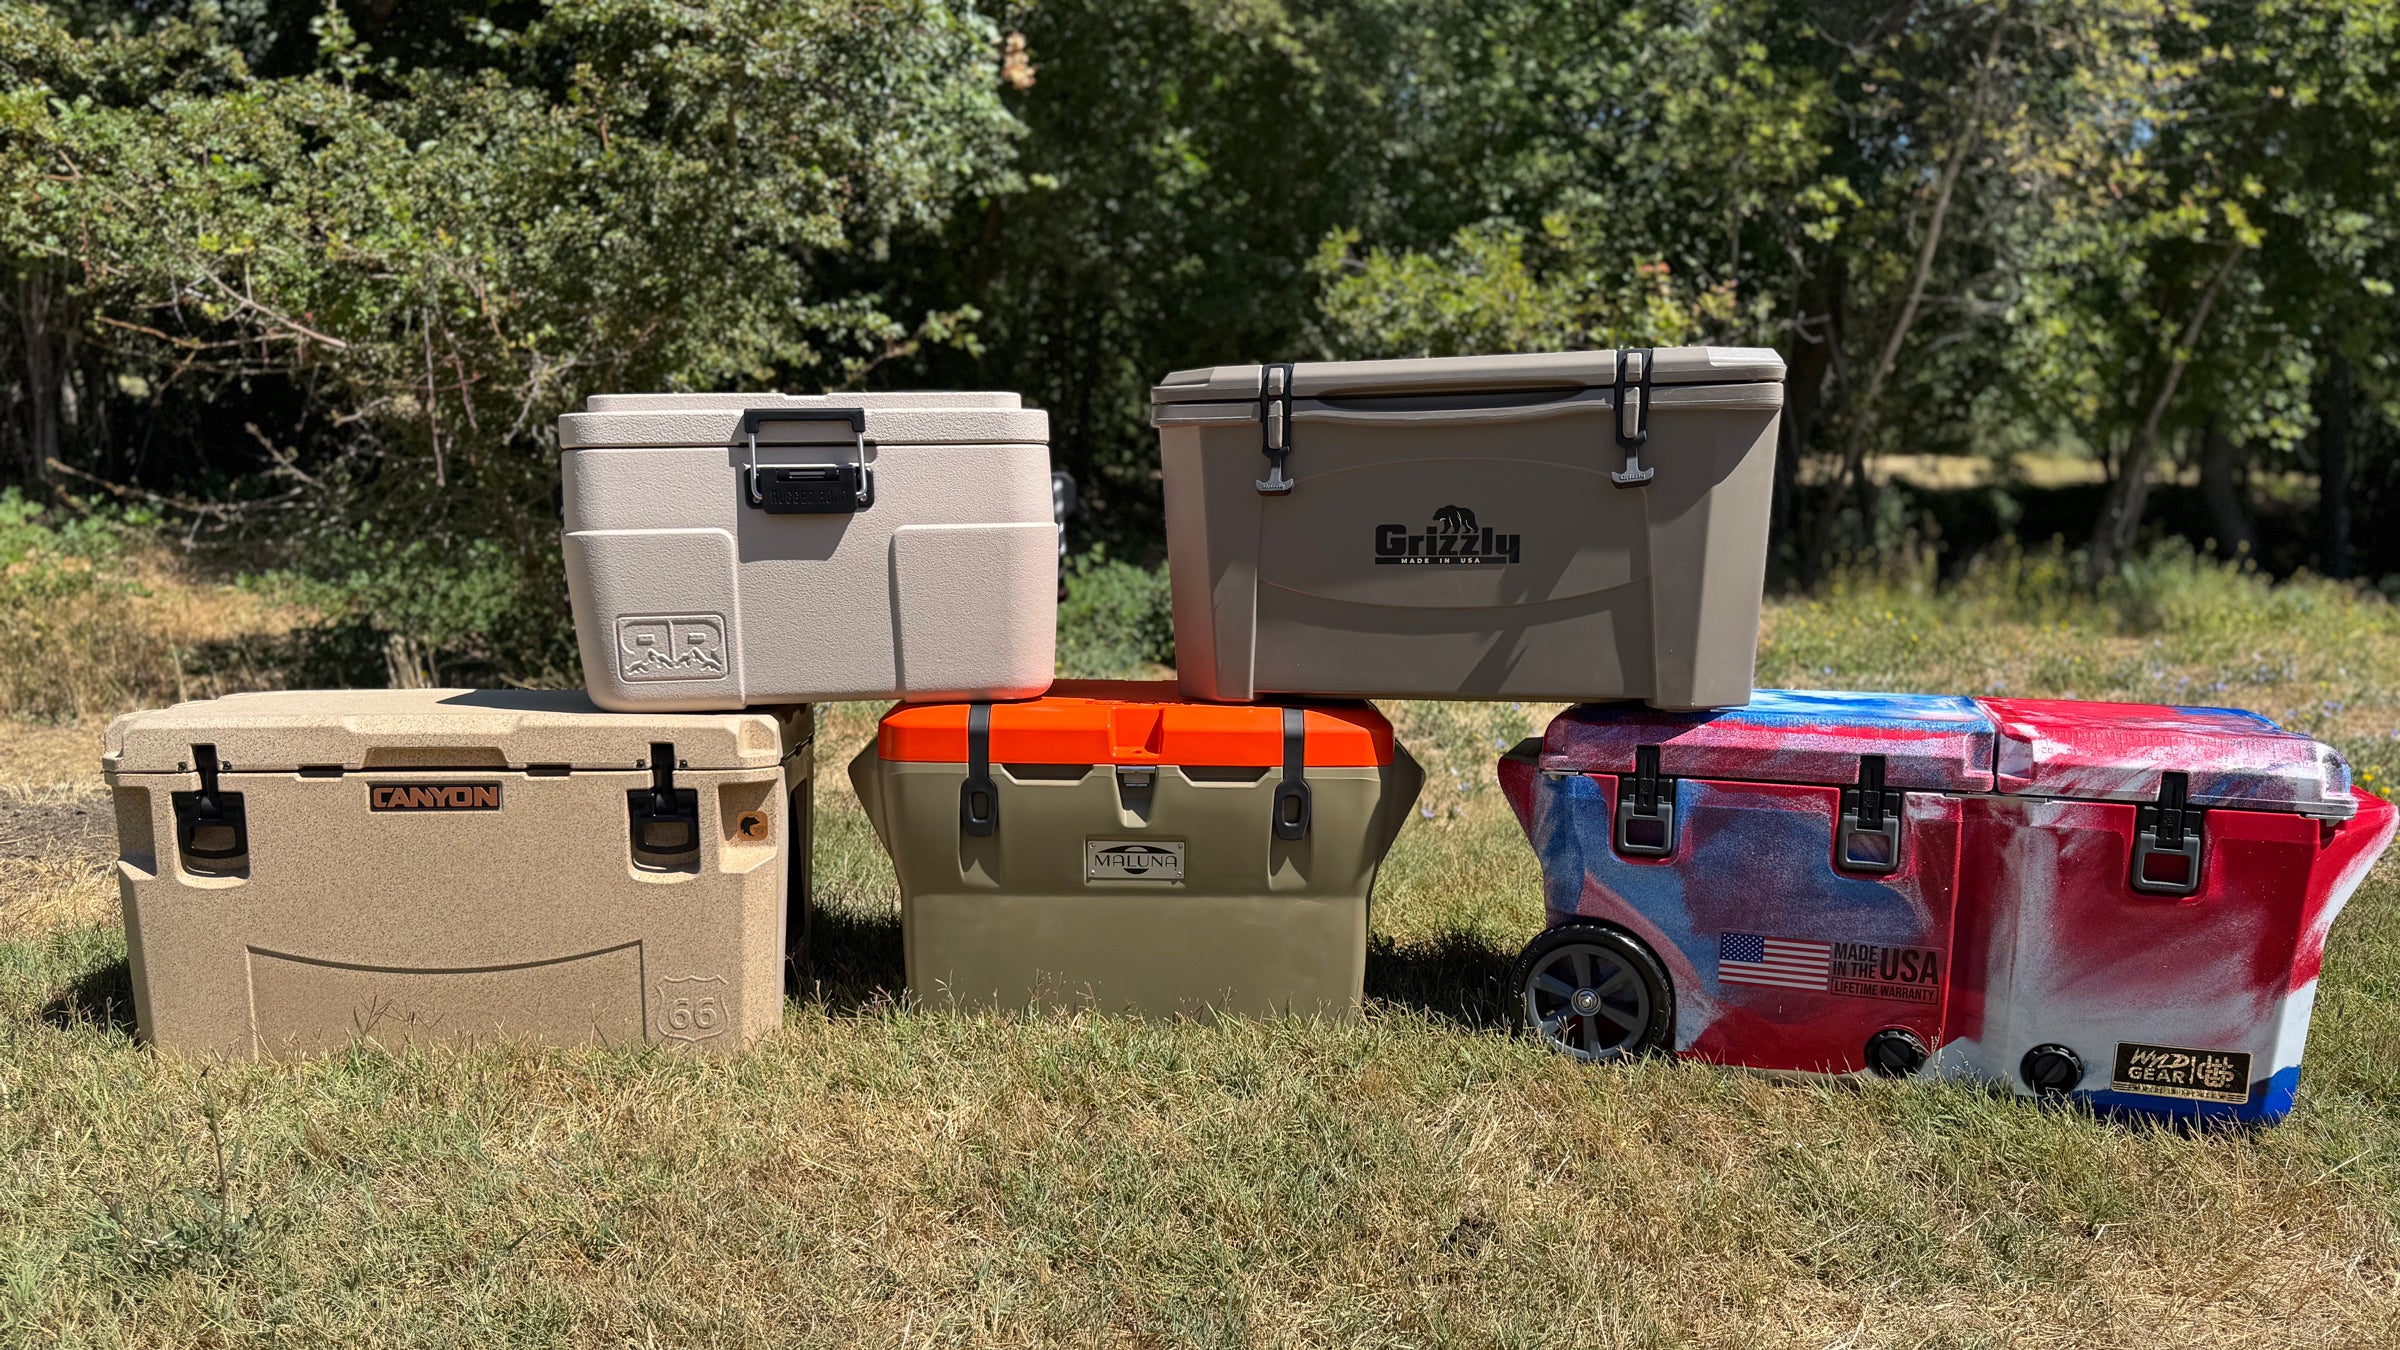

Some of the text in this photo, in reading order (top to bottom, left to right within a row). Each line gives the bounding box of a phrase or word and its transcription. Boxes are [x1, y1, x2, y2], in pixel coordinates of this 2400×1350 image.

[770, 489, 815, 505] RUGGED
[1375, 524, 1521, 564] Grizzly
[373, 786, 498, 808] CANYON
[1094, 854, 1178, 869] MALUNA
[1834, 942, 1879, 962] MADE
[1832, 960, 1878, 979] IN THE
[1880, 947, 1939, 985] USA
[1834, 980, 1935, 1001] LIFETIME WARRANTY
[668, 997, 717, 1030] 66
[2127, 1066, 2186, 1085] GEAR
